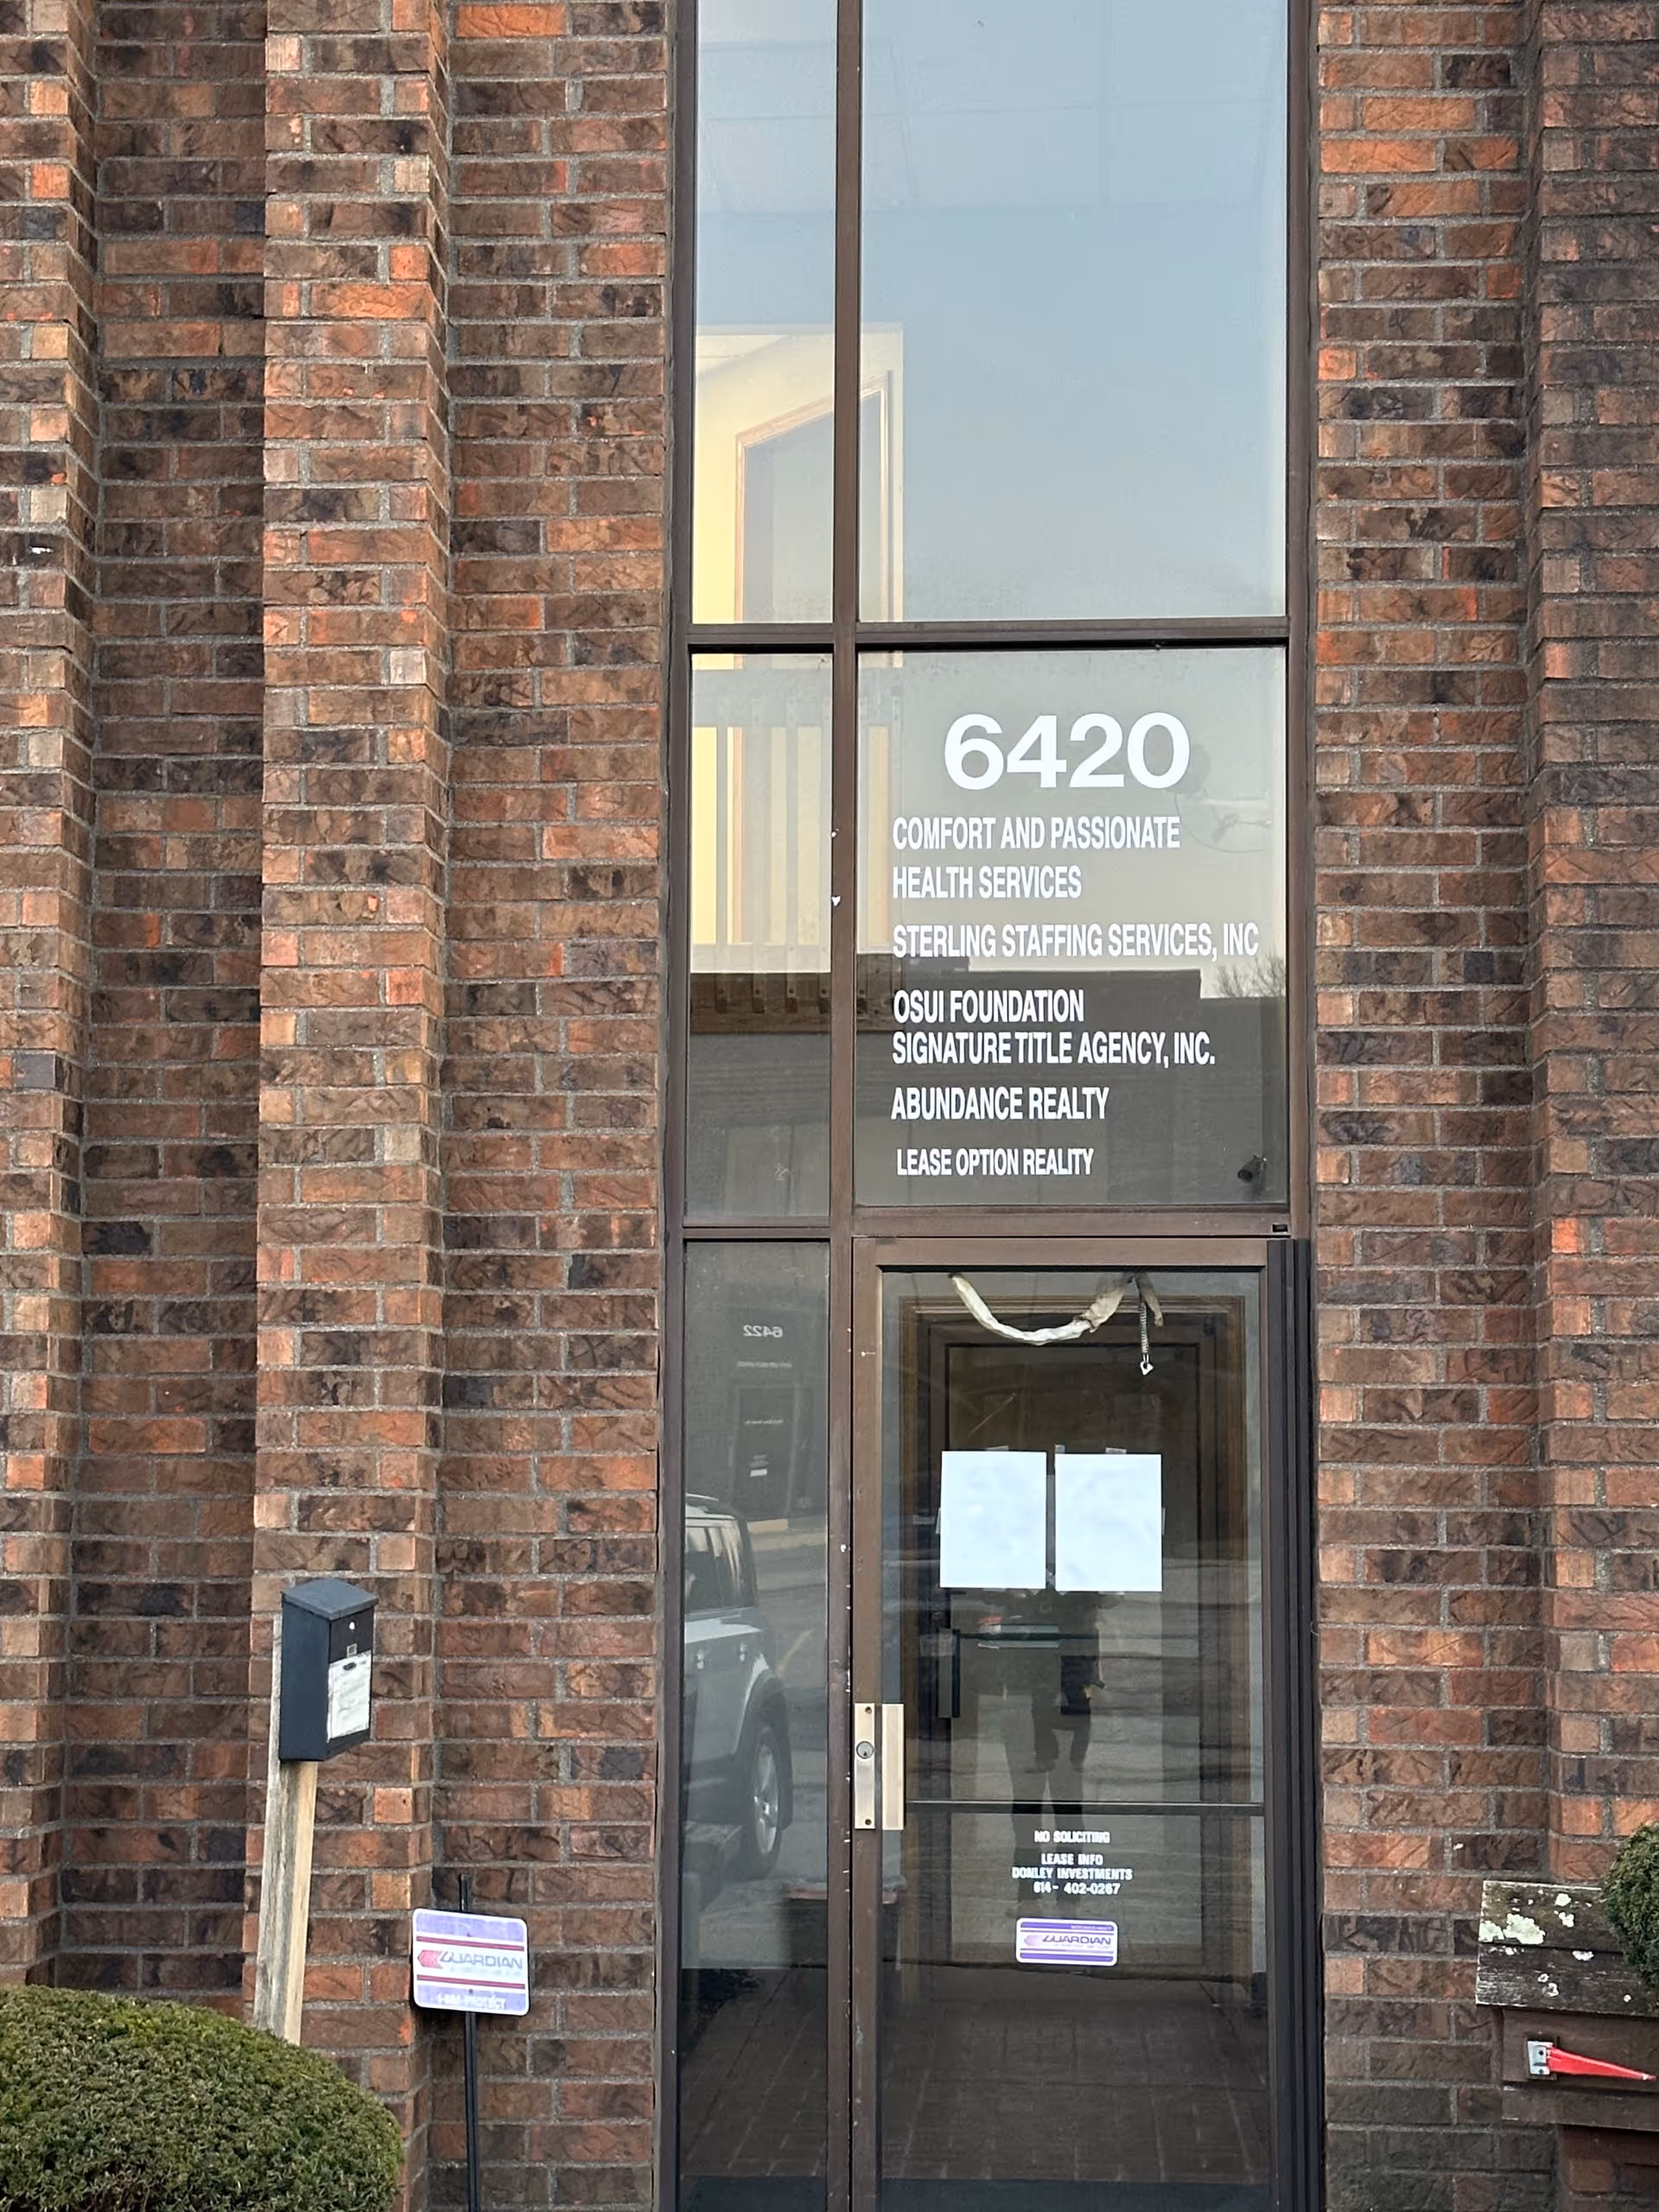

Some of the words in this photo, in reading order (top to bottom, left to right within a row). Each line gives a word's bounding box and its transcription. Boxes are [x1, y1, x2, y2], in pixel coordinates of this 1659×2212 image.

[944, 712, 1190, 791] 6420
[893, 817, 996, 850] COMFORT
[1000, 817, 1046, 849] AND
[1051, 816, 1180, 849] PASSIONATE
[893, 866, 973, 899] HEALTH
[979, 865, 1082, 899] SERVICES
[893, 924, 996, 958] STERLING
[1001, 923, 1103, 957] STAFFING
[1108, 922, 1217, 962] SERVICES,
[1224, 922, 1259, 957] INC
[893, 989, 944, 1024] OSUI
[950, 988, 1084, 1023] FOUNDATION
[892, 1031, 1012, 1065] SIGNATURE
[1014, 1031, 1073, 1064] TITLE
[1077, 1031, 1169, 1069] AGENCY,
[1173, 1031, 1216, 1065] INC.
[890, 1086, 1023, 1121] ABUNDANCE
[1028, 1086, 1109, 1120] REALTY
[897, 1147, 952, 1176] LEASE
[955, 1147, 1020, 1176] OPTION
[1022, 1147, 1095, 1176] REALITY
[1033, 1830, 1051, 1843] NO
[1052, 1830, 1110, 1844] SOLICITING
[1041, 1853, 1074, 1866] LEASE
[1077, 1853, 1103, 1866] INFO
[1057, 1867, 1133, 1881] INVESTMENTS
